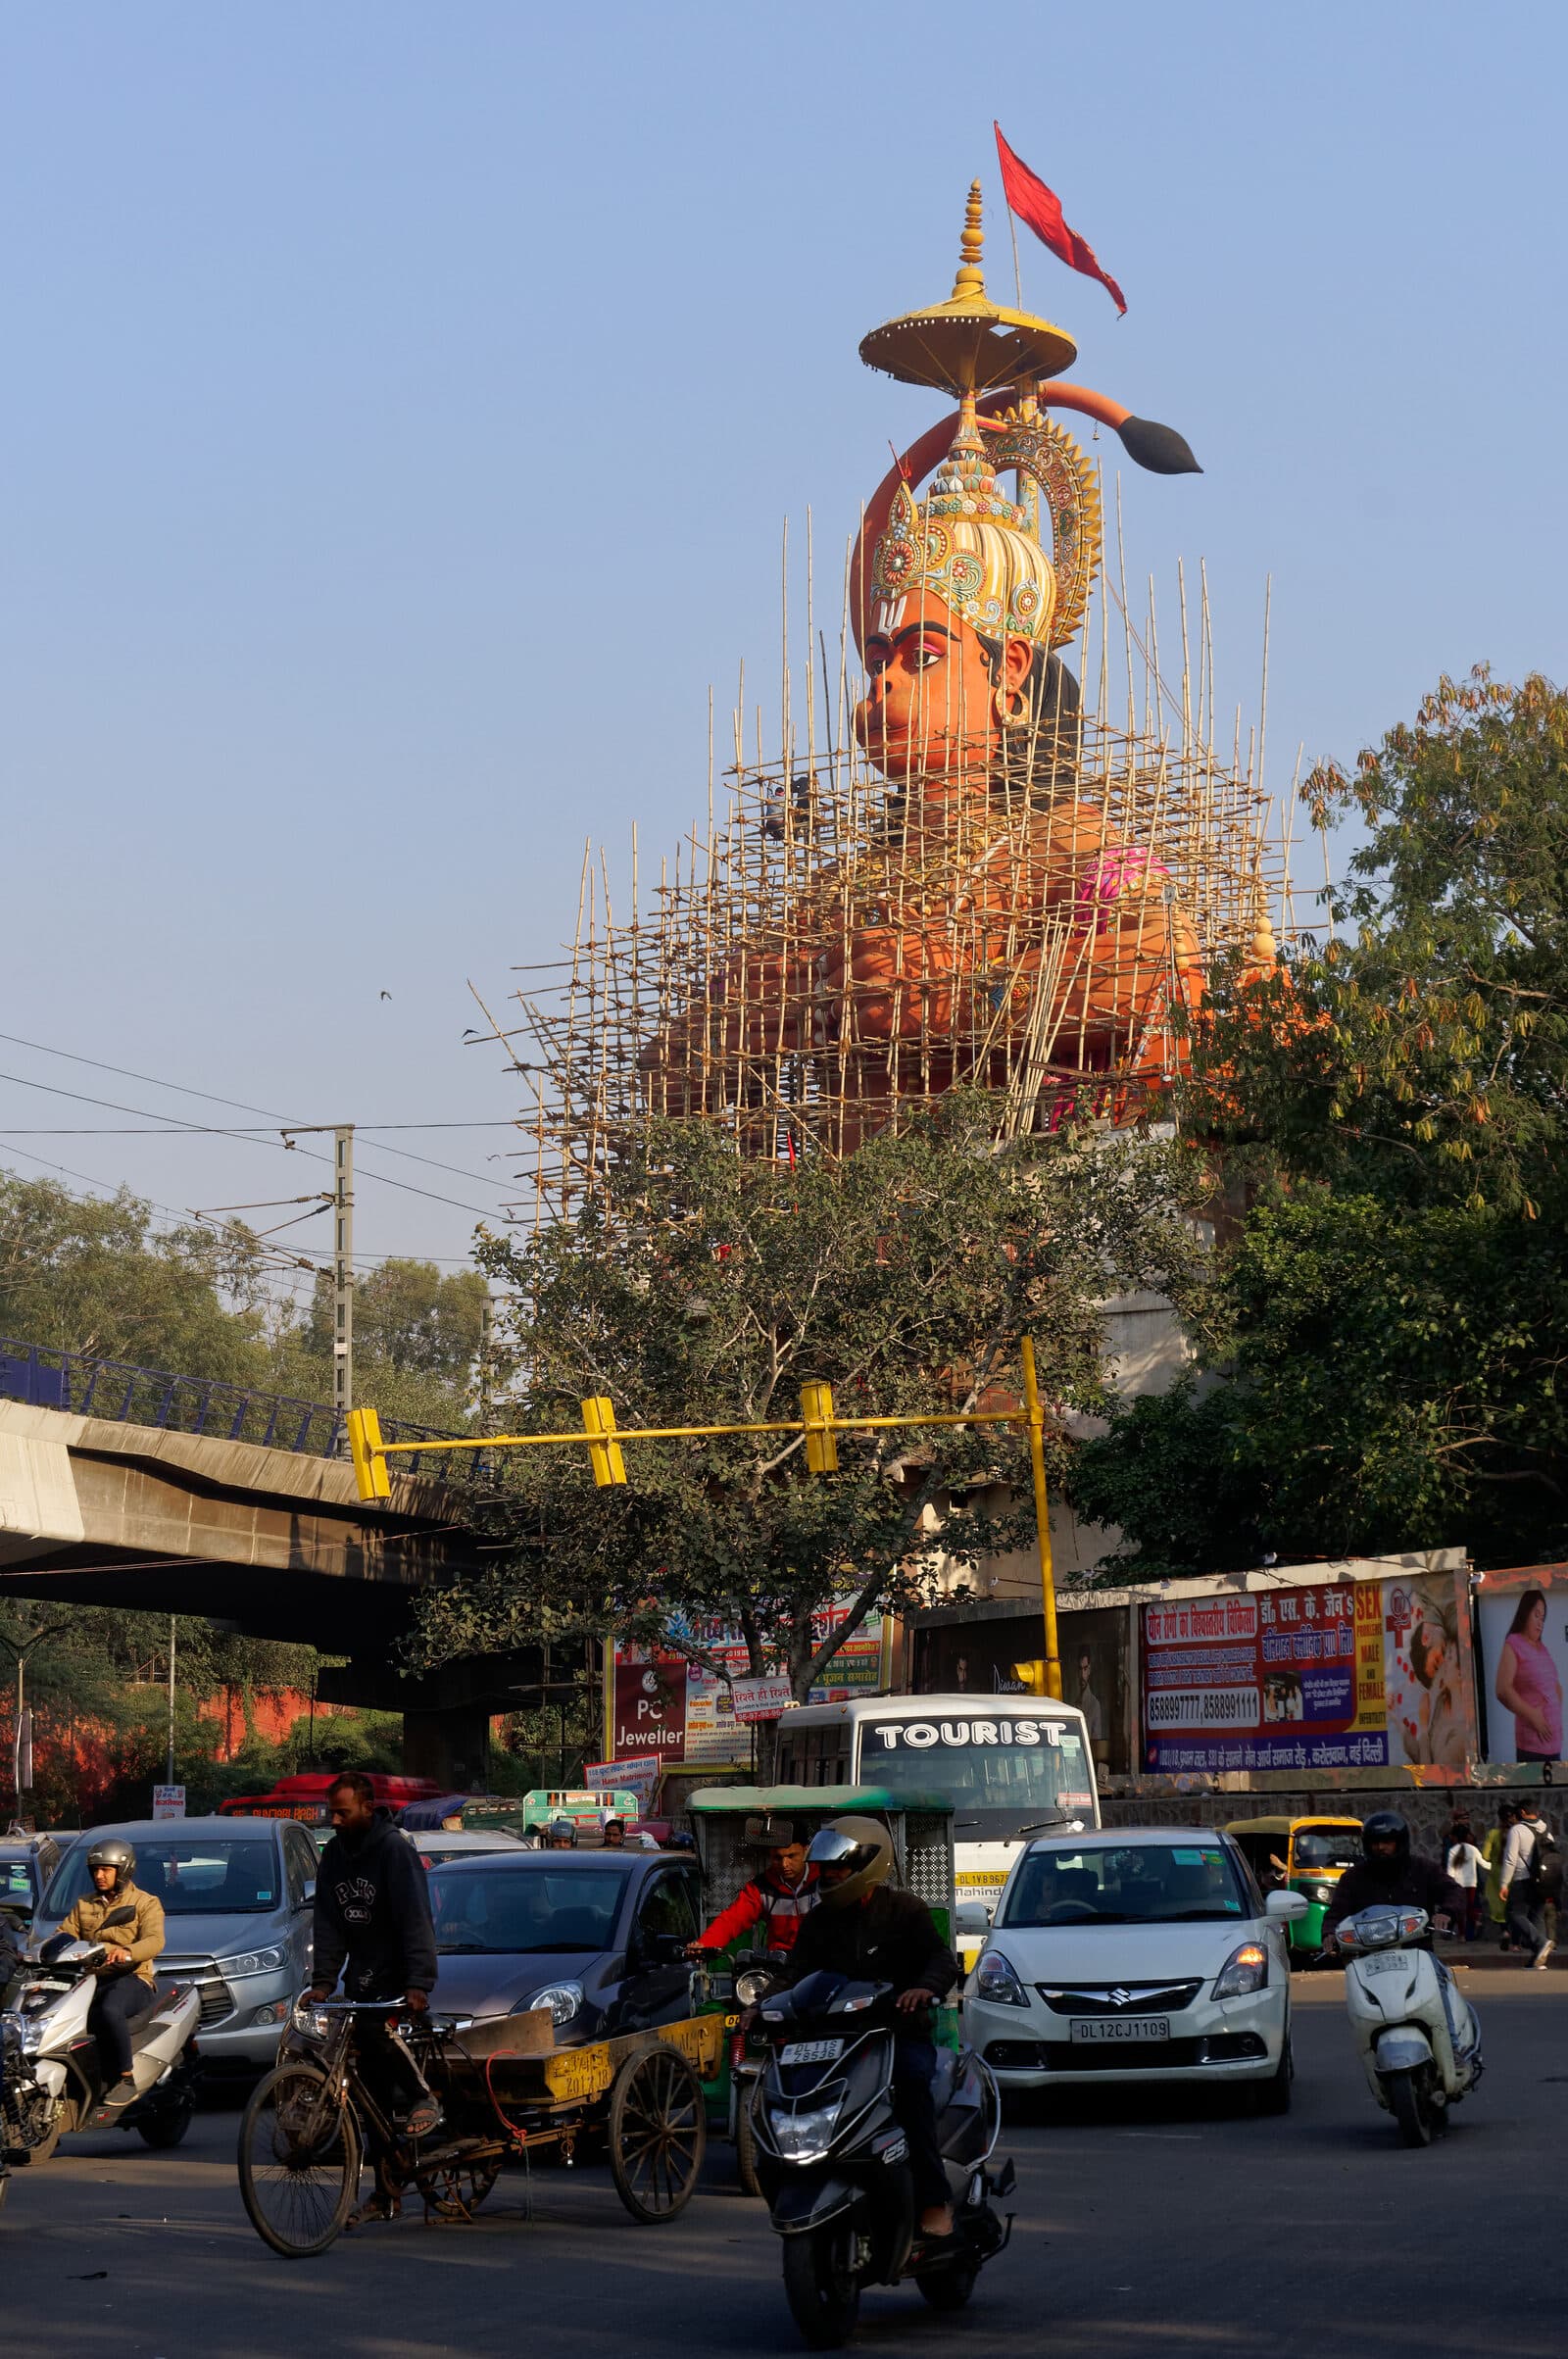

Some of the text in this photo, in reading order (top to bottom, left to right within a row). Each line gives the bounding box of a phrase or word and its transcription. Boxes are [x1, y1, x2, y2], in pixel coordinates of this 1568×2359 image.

[1356, 1584, 1382, 1621] SEX
[1361, 1645, 1380, 1663] MALE
[1359, 1682, 1385, 1701] FEMALE
[637, 1698, 663, 1720] PC
[616, 1725, 683, 1745] Jeweller
[875, 1721, 1066, 1749] TOURIST
[955, 1887, 1004, 1897] Mahind
[1081, 2021, 1167, 2039] DL12CJ1109
